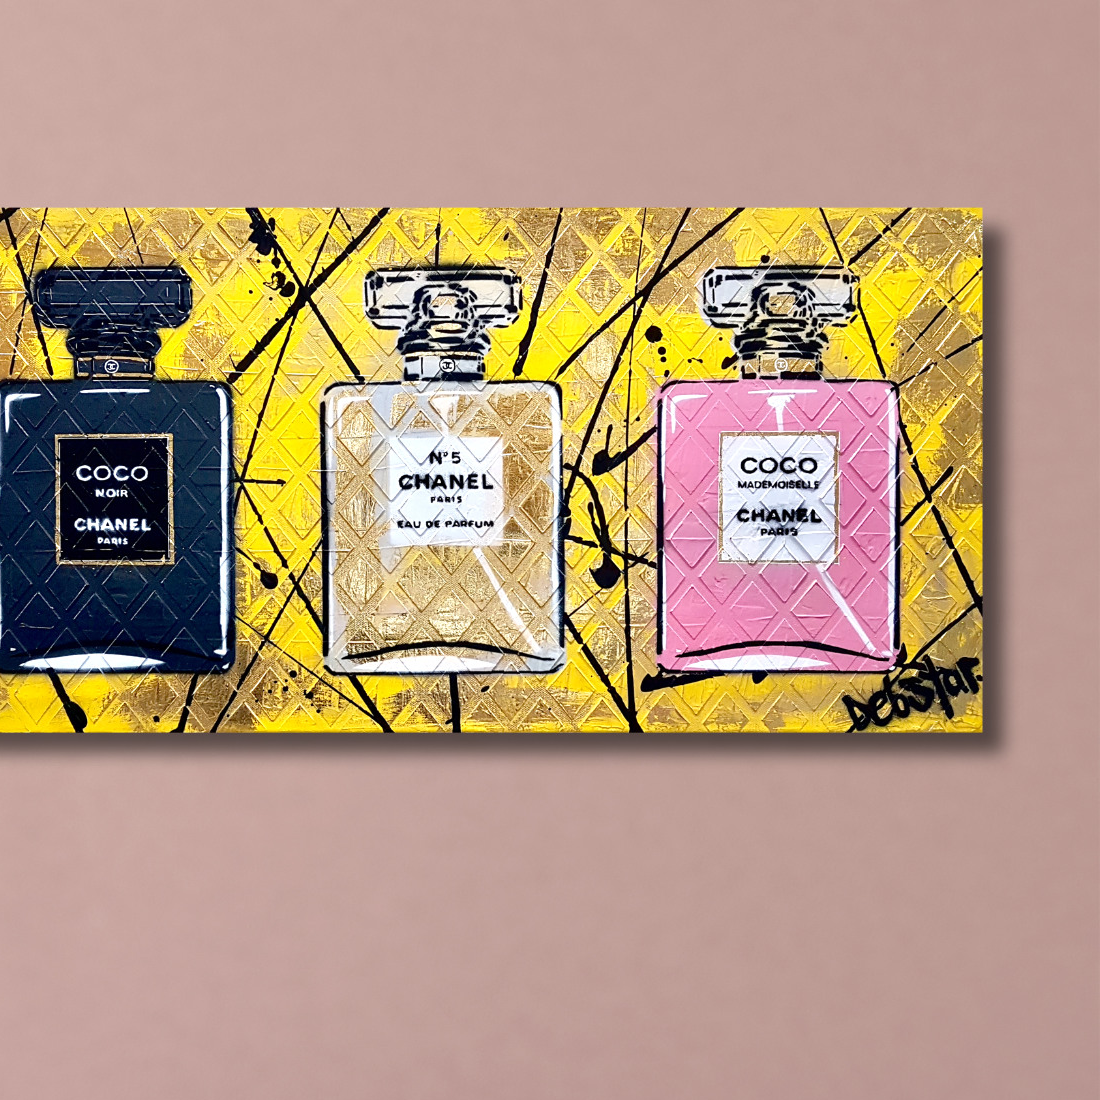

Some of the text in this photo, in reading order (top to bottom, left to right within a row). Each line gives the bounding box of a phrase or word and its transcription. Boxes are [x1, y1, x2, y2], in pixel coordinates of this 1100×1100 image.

[740, 457, 818, 474] COCO
[75, 465, 149, 482] COCO
[398, 473, 494, 490] CHANEL
[737, 480, 820, 490] MADEMOISELLE
[95, 488, 129, 498] NOIR
[430, 496, 463, 504] PARIS
[736, 508, 823, 523] CHANEL
[73, 517, 152, 531] CHANEL
[397, 520, 495, 529] EAU DE PARFUM
[760, 527, 799, 537] PARIS
[97, 537, 129, 546] PARIS
